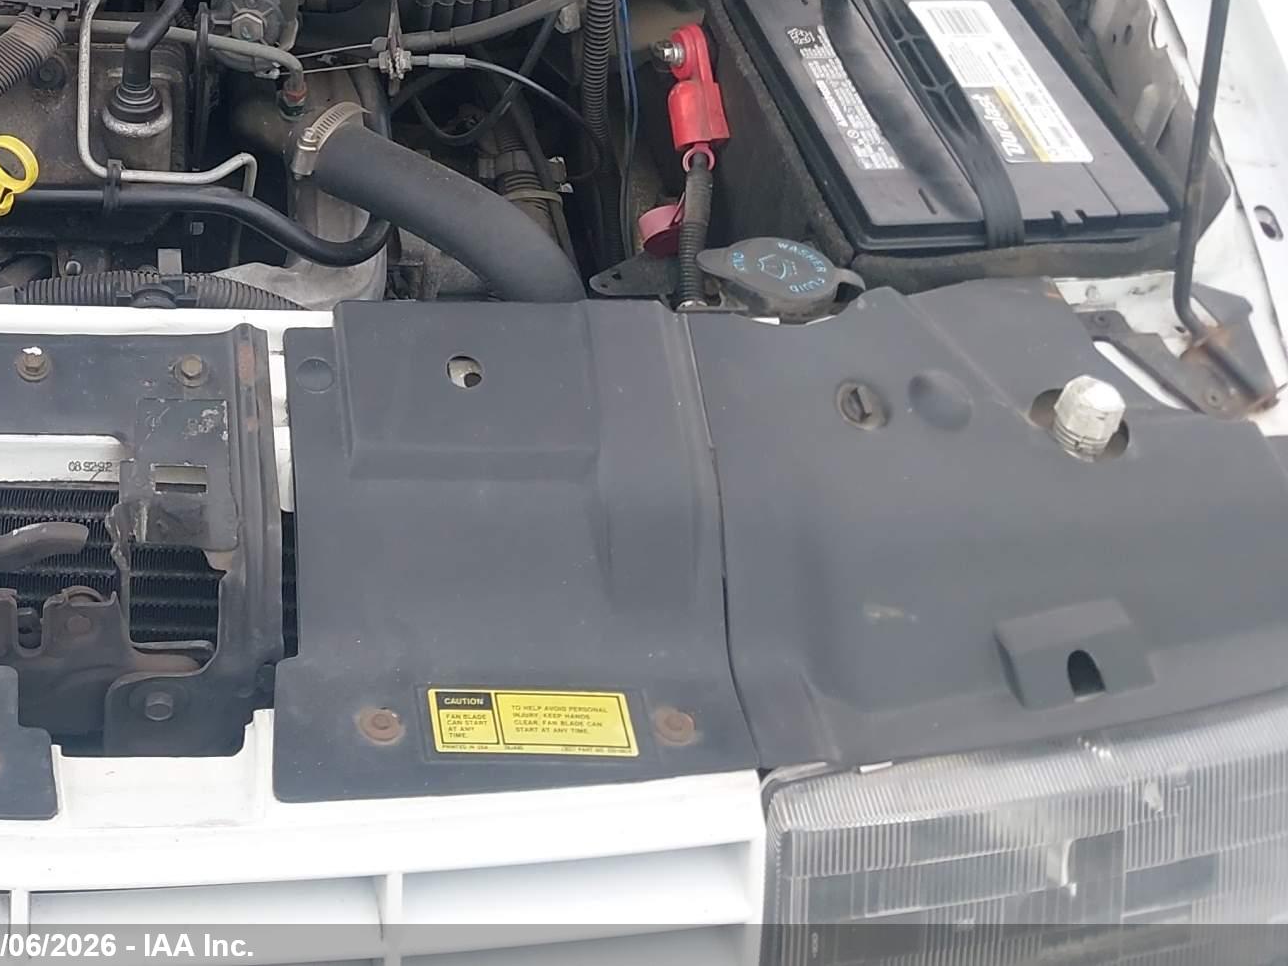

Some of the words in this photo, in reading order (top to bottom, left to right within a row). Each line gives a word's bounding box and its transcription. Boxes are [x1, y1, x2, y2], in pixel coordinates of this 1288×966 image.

[971, 94, 1025, 157] Duralast
[777, 242, 827, 273] WASHER
[443, 697, 484, 705] CAUTION
